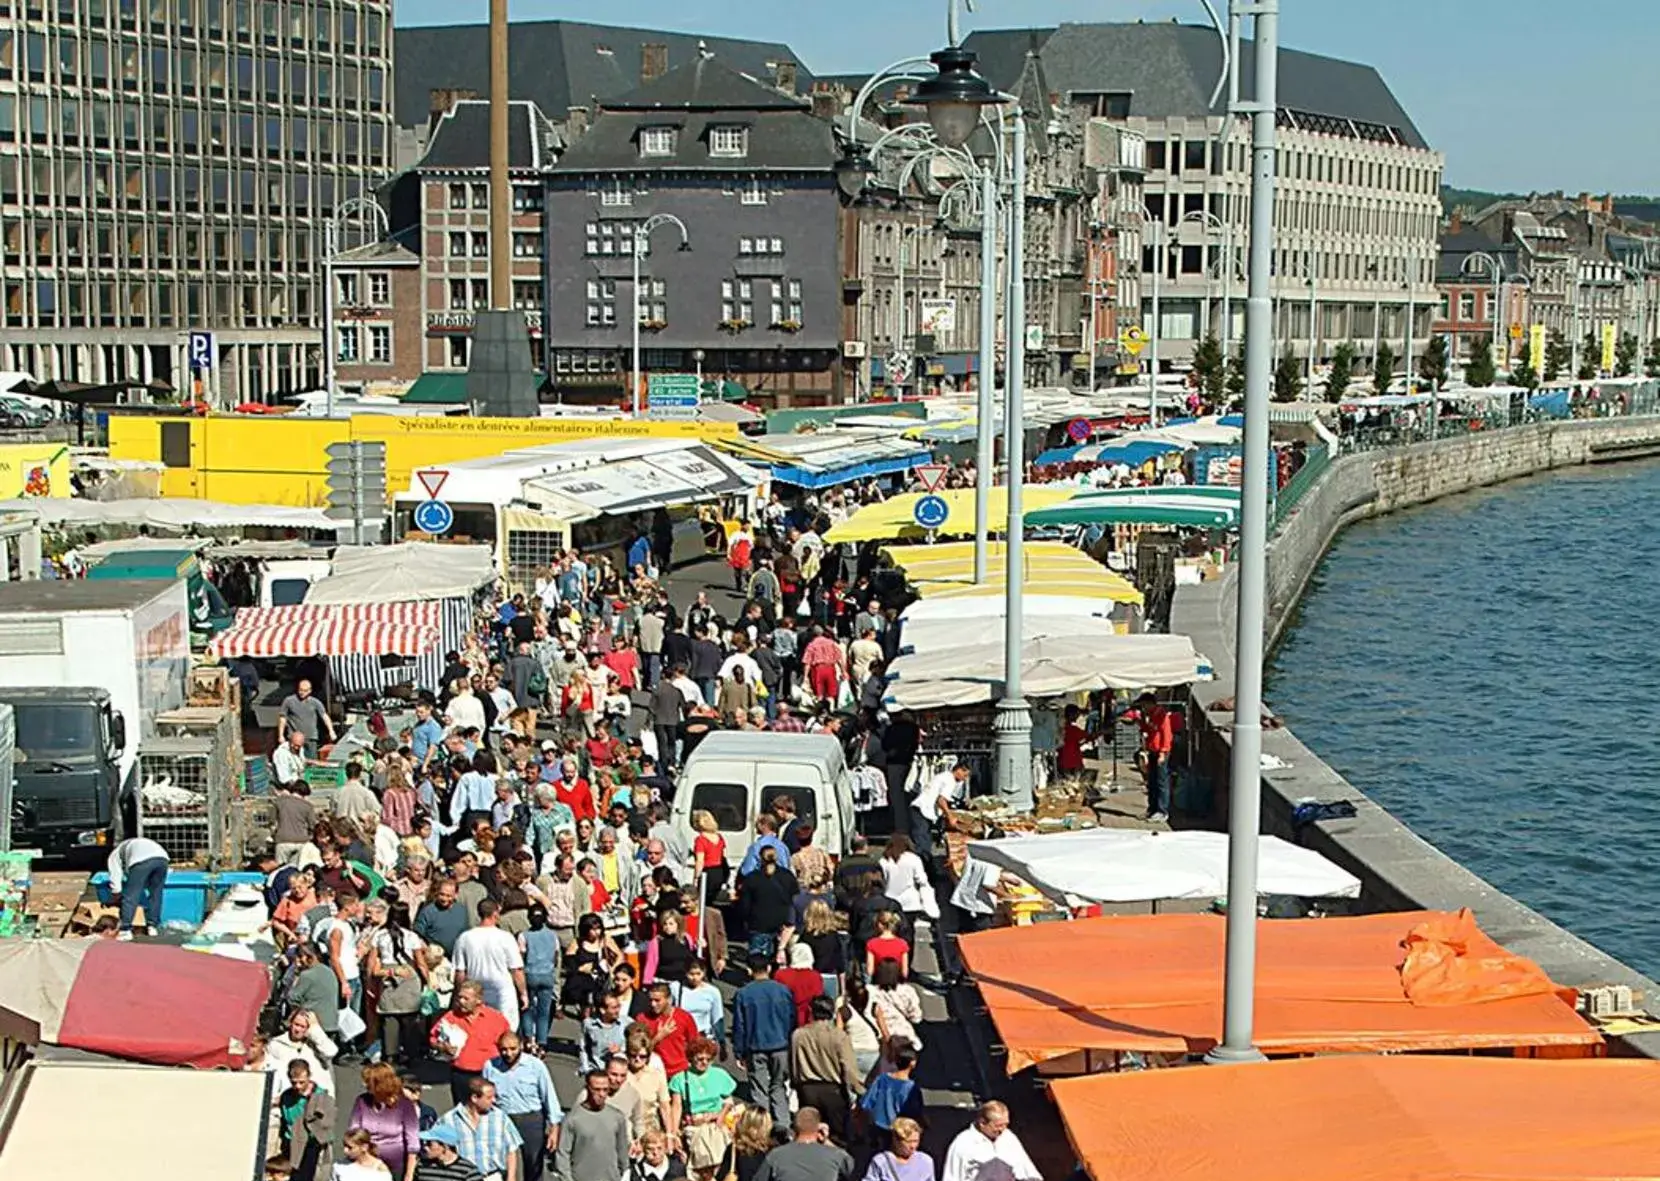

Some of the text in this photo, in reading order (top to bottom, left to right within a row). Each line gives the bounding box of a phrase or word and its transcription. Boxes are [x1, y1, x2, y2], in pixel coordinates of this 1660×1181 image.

[193, 335, 207, 360] P
[398, 419, 650, 434] Spécialiste en denrées alimentaires italiennes
